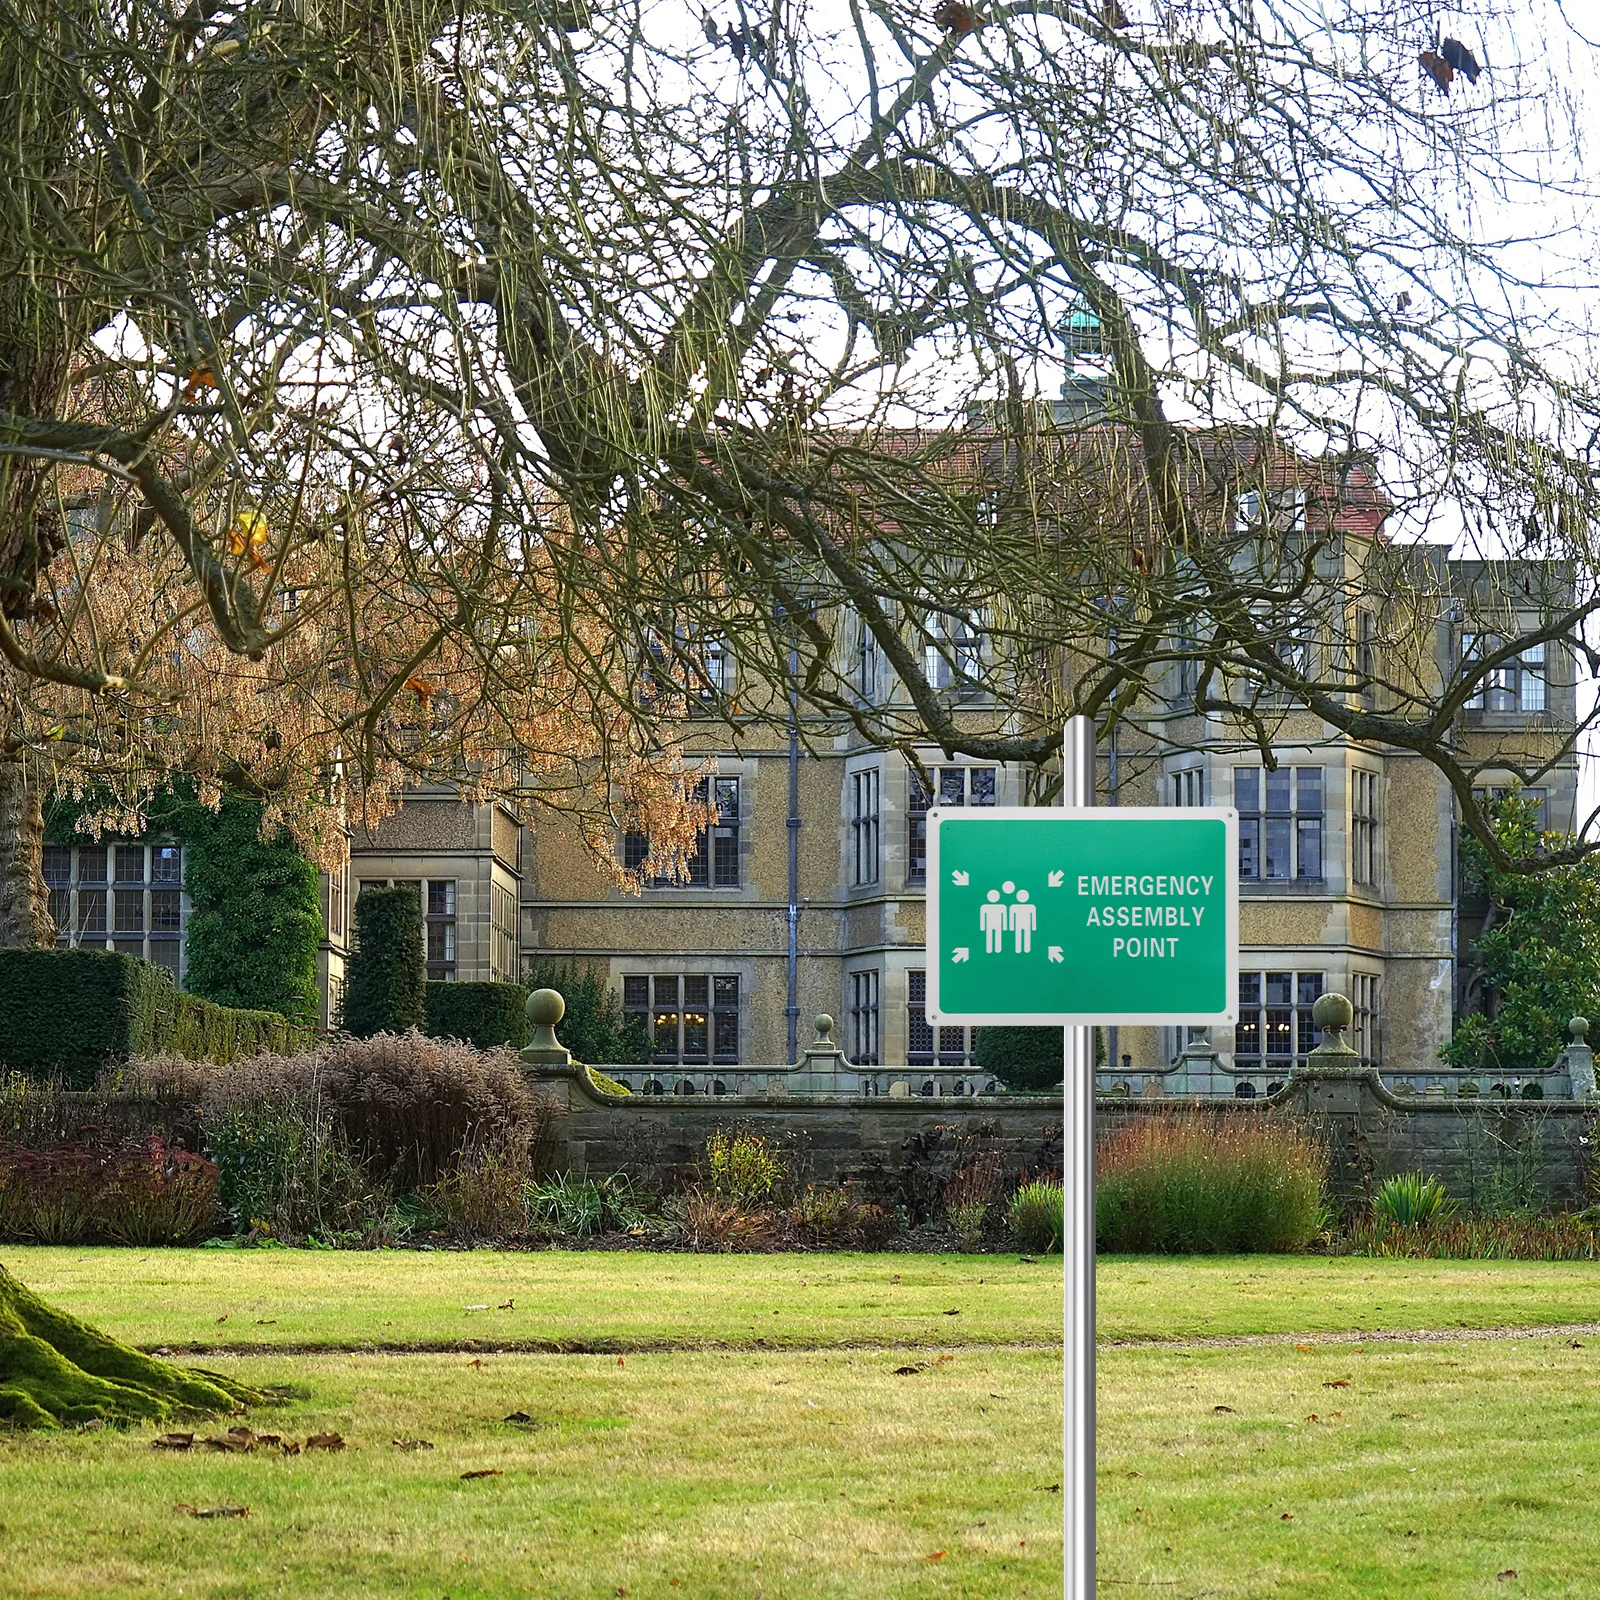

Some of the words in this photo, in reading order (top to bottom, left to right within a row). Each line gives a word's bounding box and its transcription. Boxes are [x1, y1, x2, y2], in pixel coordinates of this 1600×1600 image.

[1077, 875, 1214, 896] EMERGENCY
[1086, 906, 1205, 927] ASSEMBLY
[1113, 937, 1179, 958] POINT
